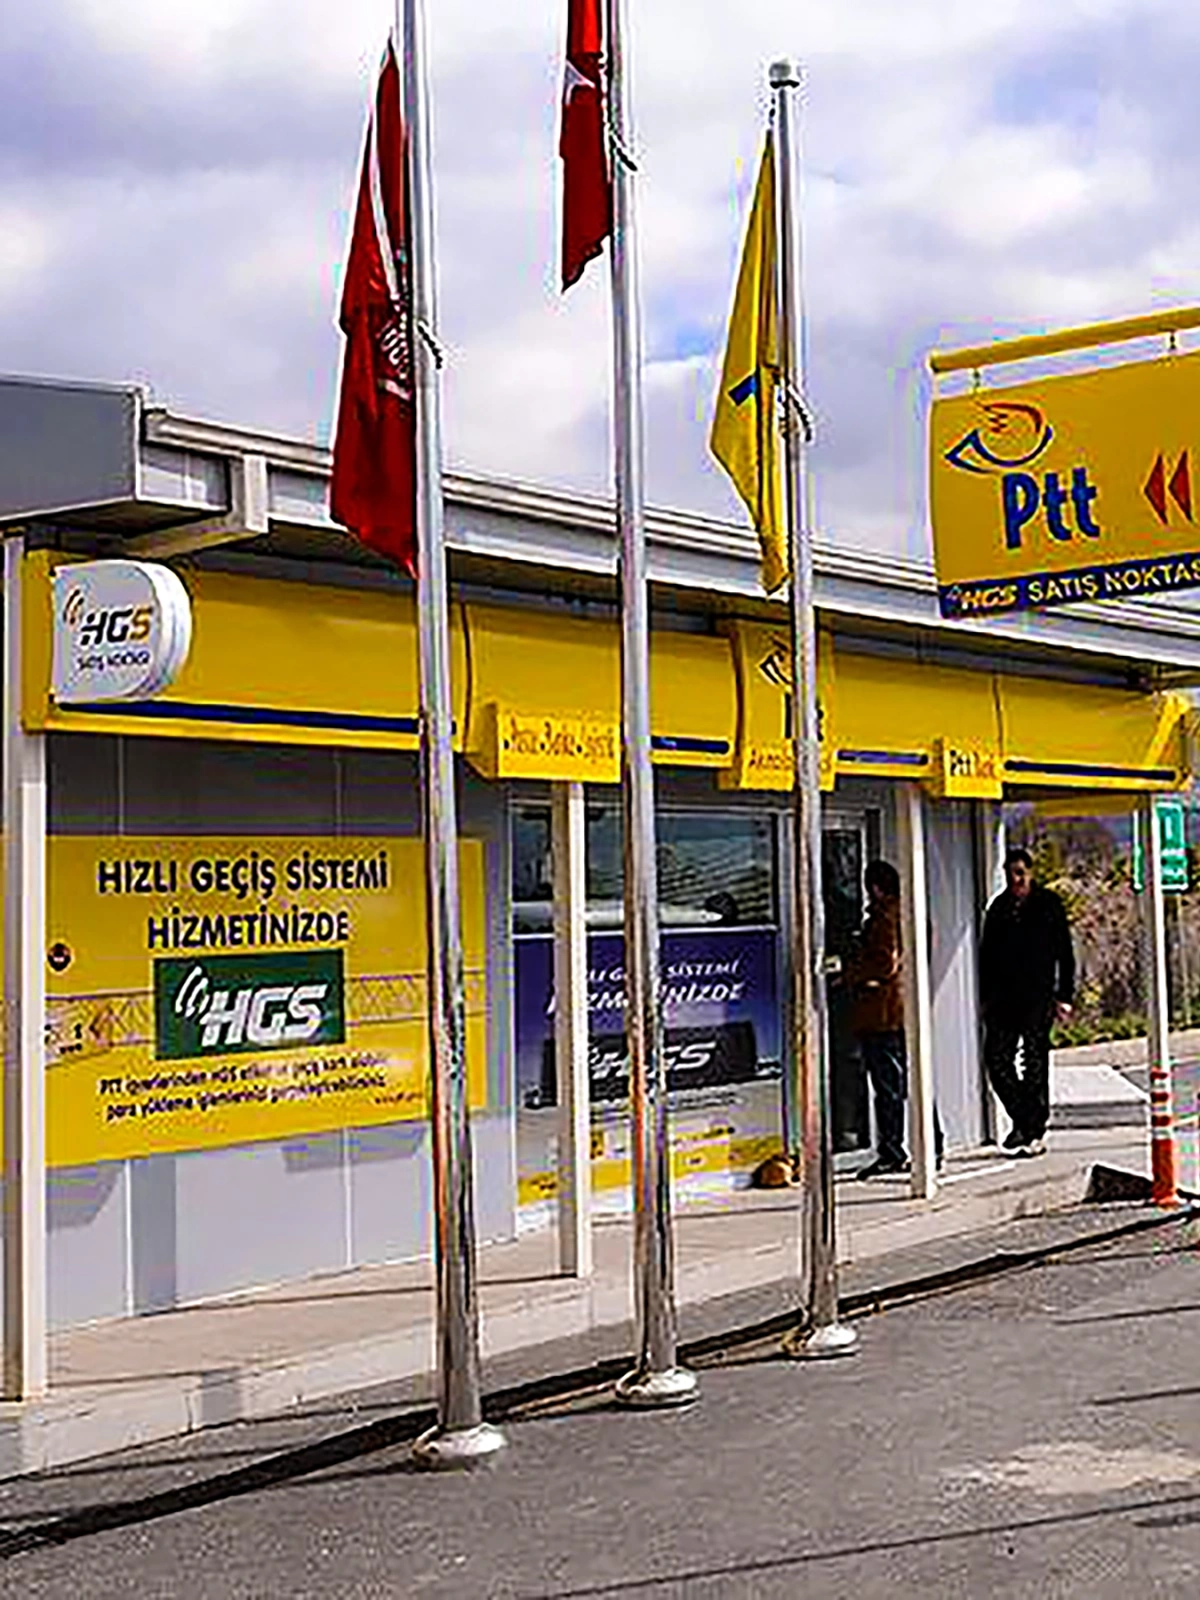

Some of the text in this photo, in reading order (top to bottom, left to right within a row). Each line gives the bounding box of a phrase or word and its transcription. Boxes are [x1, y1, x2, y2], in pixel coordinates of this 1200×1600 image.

[1002, 467, 1100, 549] Ptt
[81, 606, 153, 646] HGS
[98, 851, 387, 899] HIZLI GEÇİŞ SİSTEMİ
[147, 904, 350, 949] HİZMETİNİZDE
[201, 983, 328, 1047] HGS
